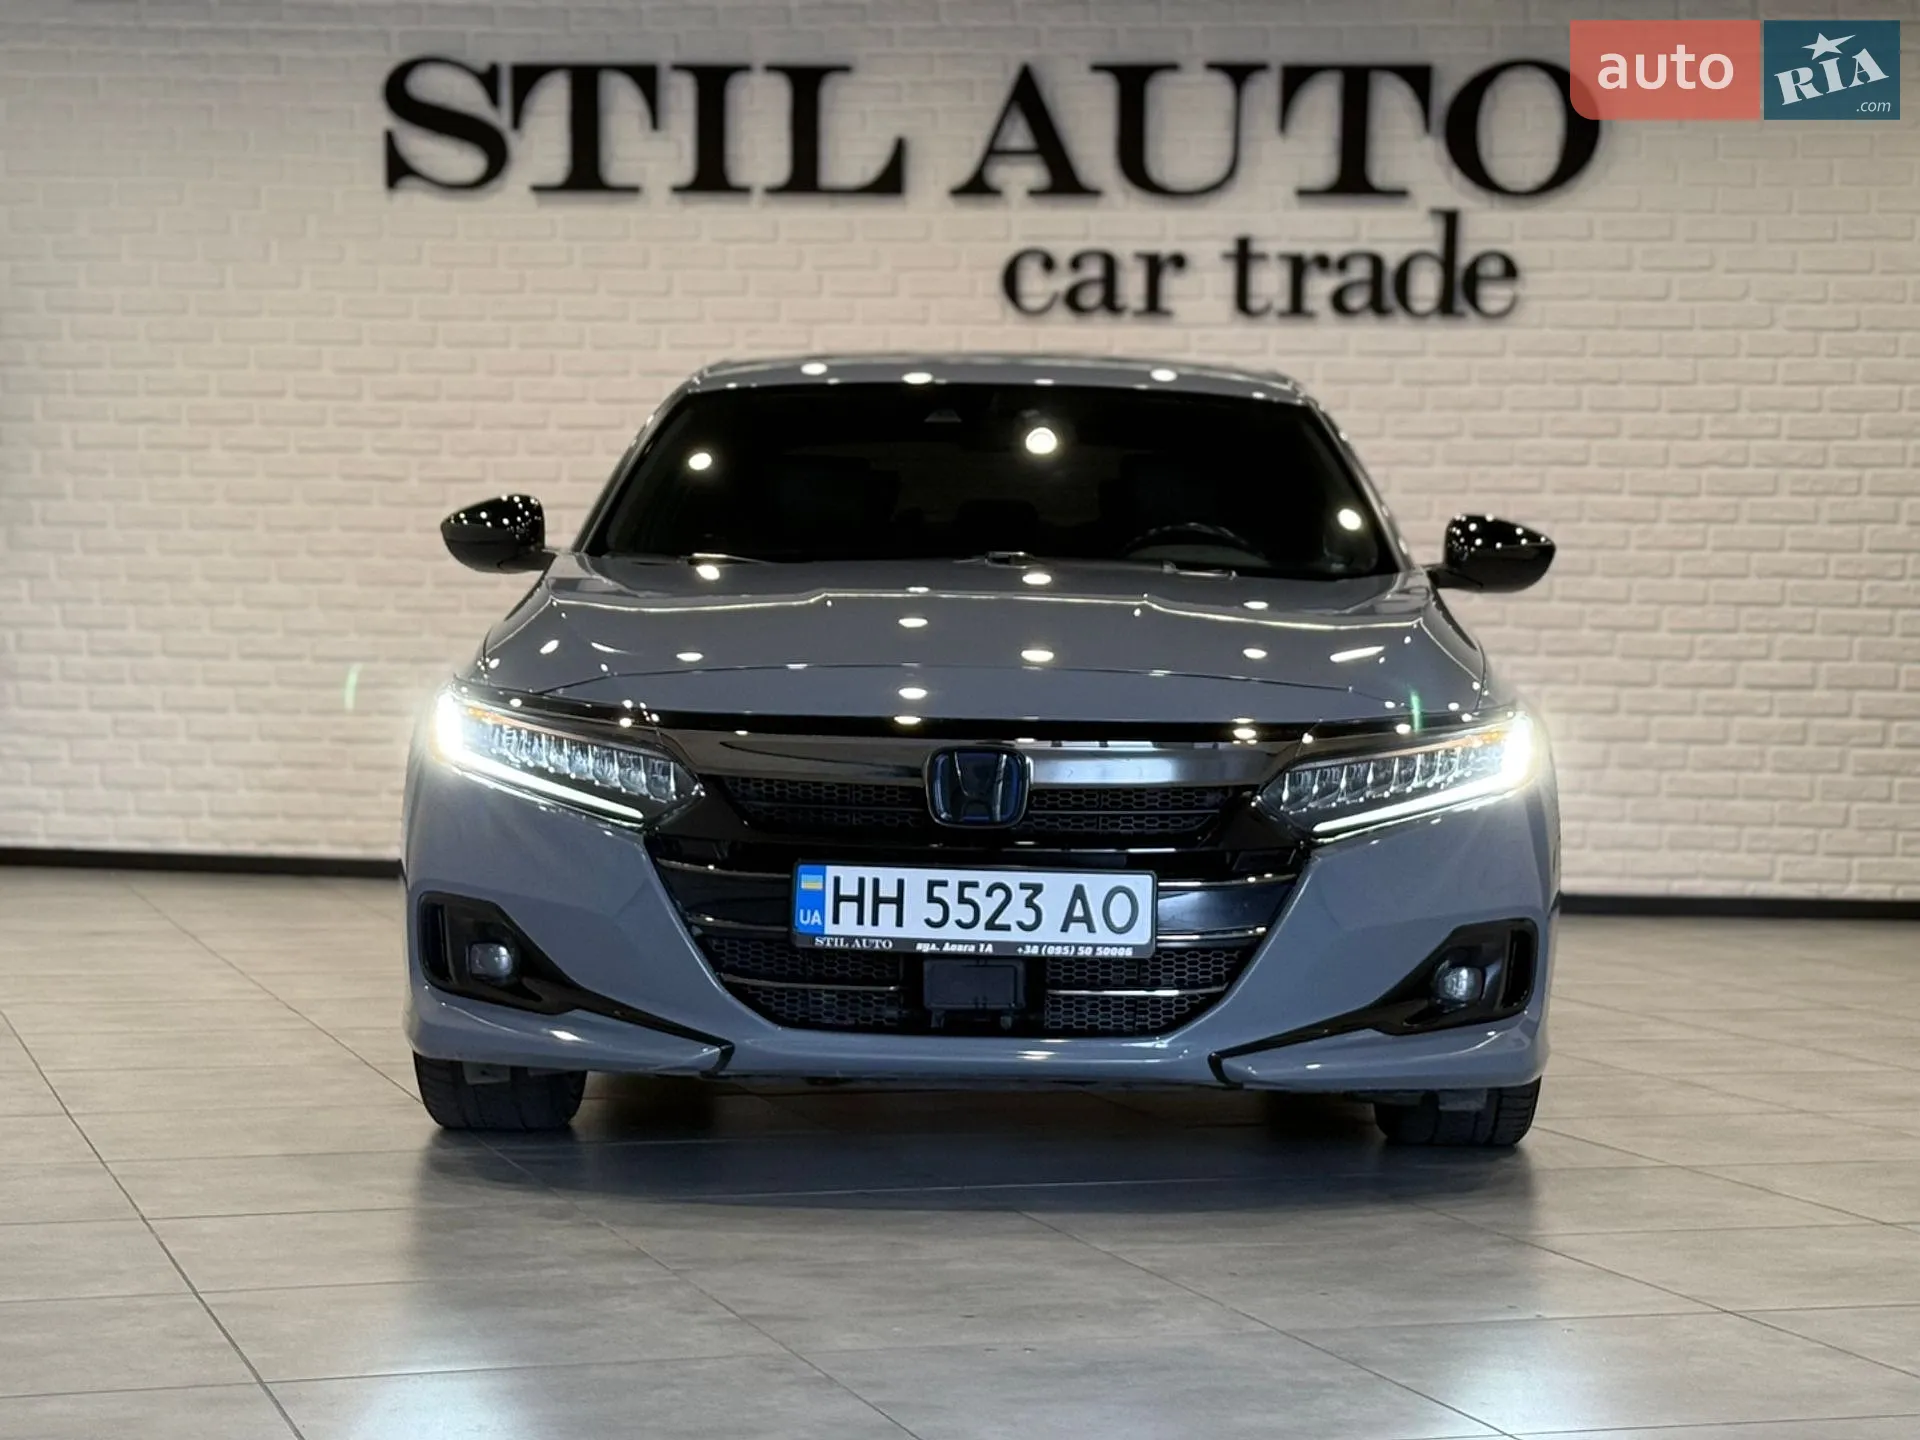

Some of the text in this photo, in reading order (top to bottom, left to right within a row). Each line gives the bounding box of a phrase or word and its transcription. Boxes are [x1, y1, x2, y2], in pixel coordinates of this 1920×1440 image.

[384, 55, 1600, 197] STIL AUTO
[1002, 208, 1519, 319] car trade
[799, 908, 822, 926] UA
[831, 875, 1140, 935] HH 5523 AO
[814, 936, 893, 950] STIL AUTO
